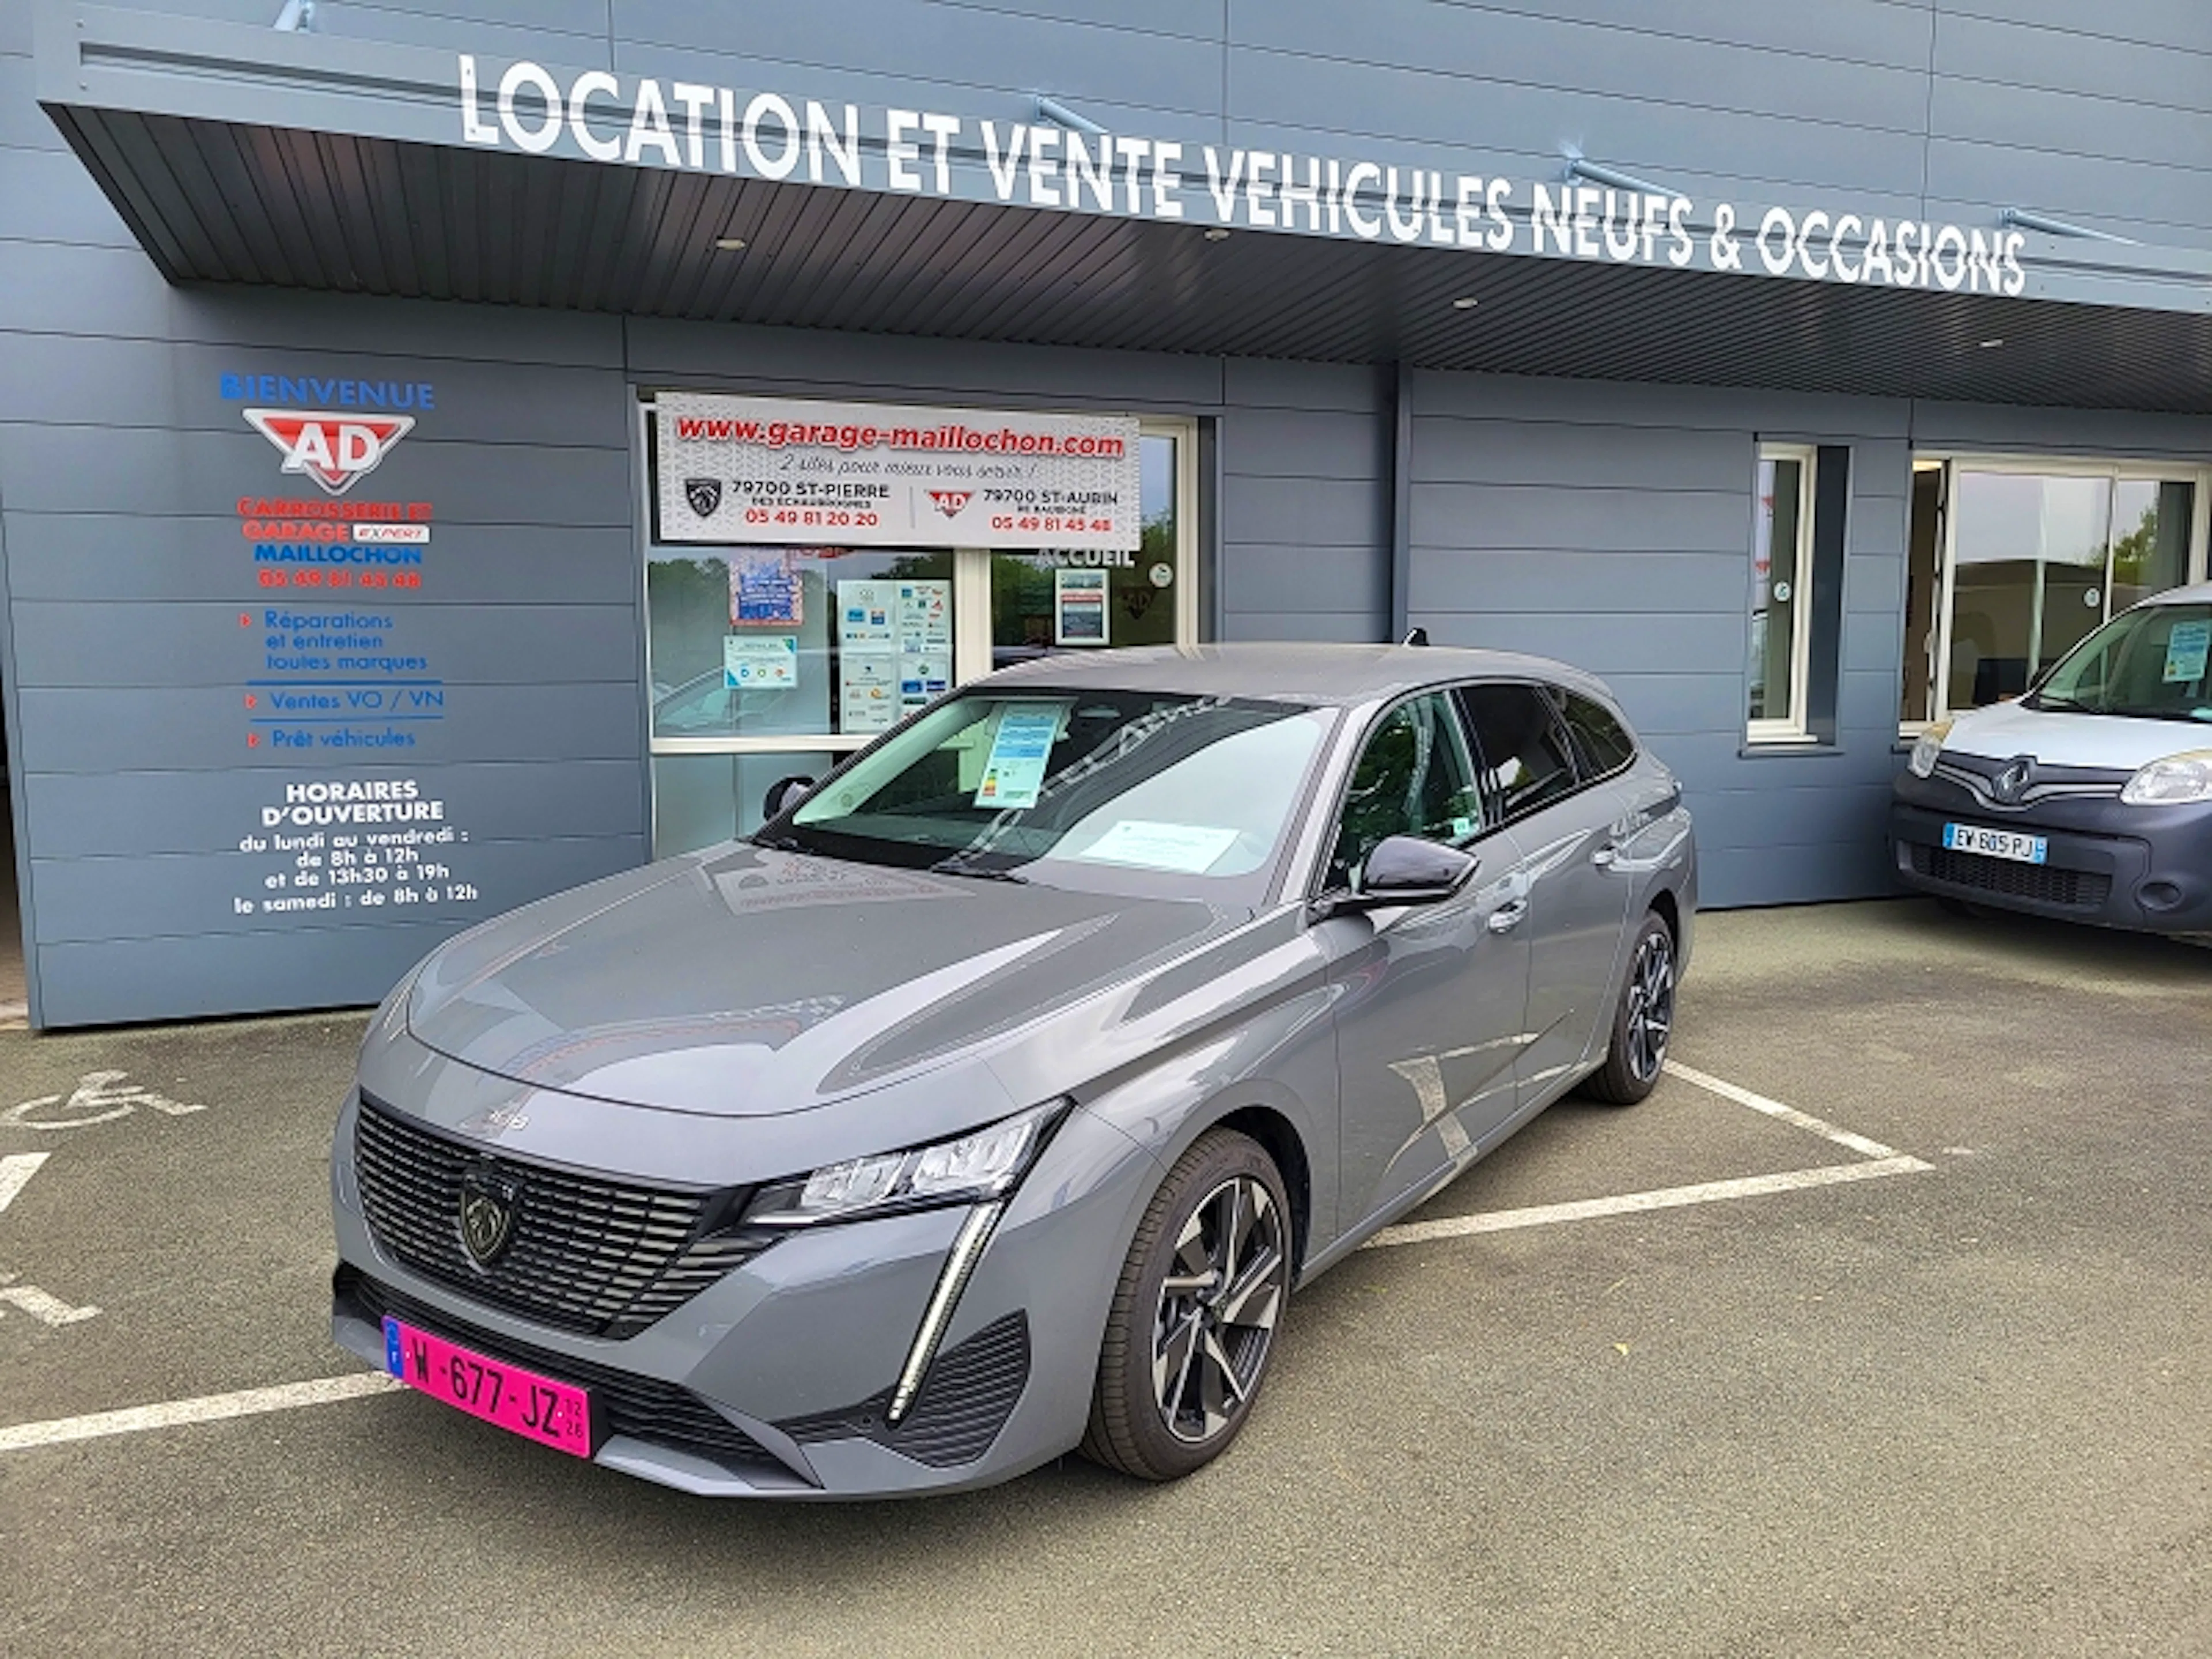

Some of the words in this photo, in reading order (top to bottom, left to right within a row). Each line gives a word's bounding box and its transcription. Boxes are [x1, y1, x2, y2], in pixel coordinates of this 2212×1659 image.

[459, 54, 862, 186] LOCATION
[887, 109, 960, 194] ET
[980, 120, 1183, 218] VENTE
[1203, 146, 1512, 251] VEHICULES
[1531, 183, 1694, 266] NEUFS
[1710, 204, 1741, 270] &
[1755, 206, 2025, 296] OCCASIONS
[220, 370, 435, 410] BIENVENUE
[282, 422, 381, 471] AD
[677, 417, 1124, 459] www.garage-maillochon.com
[780, 454, 794, 470] 2
[733, 480, 790, 494] 79700
[797, 482, 891, 498] ST-PIERRE
[984, 490, 1035, 503] 79700
[1042, 492, 1118, 506] ST-AUBIN
[408, 503, 433, 520] ET
[747, 509, 768, 523] 05
[775, 511, 797, 525] 49
[804, 511, 821, 525] 81
[827, 512, 849, 527] 20
[855, 513, 878, 527] 20
[242, 521, 349, 541] GARAGE
[358, 527, 423, 539] EXPERT
[992, 517, 1012, 530] 05
[1018, 518, 1040, 531] 49
[1045, 518, 1060, 532] 81
[253, 544, 422, 565] MAILLOCHON
[1037, 550, 1135, 567] ACCUEIL
[265, 609, 393, 632] Réparations
[266, 634, 285, 650] et
[293, 634, 383, 650] entretien
[266, 656, 331, 670] toutes
[337, 657, 427, 673] marques
[271, 693, 340, 709] Ventes
[348, 691, 382, 709] VO
[409, 691, 443, 707] VN
[272, 729, 313, 747] Prêt
[320, 729, 415, 747] véhicules
[286, 780, 419, 804] HORAIRES
[262, 801, 444, 827] D'OUVERTURE
[240, 835, 267, 853] du
[275, 833, 325, 850] lundi
[333, 835, 358, 848] au
[366, 827, 454, 846] vendredi
[296, 851, 322, 868] de
[330, 849, 356, 866] 8h
[364, 847, 378, 864] à
[386, 847, 419, 863] 12h
[265, 872, 286, 889] et
[294, 869, 319, 887] de
[329, 865, 388, 885] 13h30
[396, 862, 409, 881] à
[417, 865, 449, 880] 19h
[234, 897, 254, 914] le
[263, 892, 336, 912] samedi
[359, 890, 385, 907] de
[394, 887, 419, 904] 8h
[425, 885, 438, 903] à
[447, 884, 478, 900] 12h
